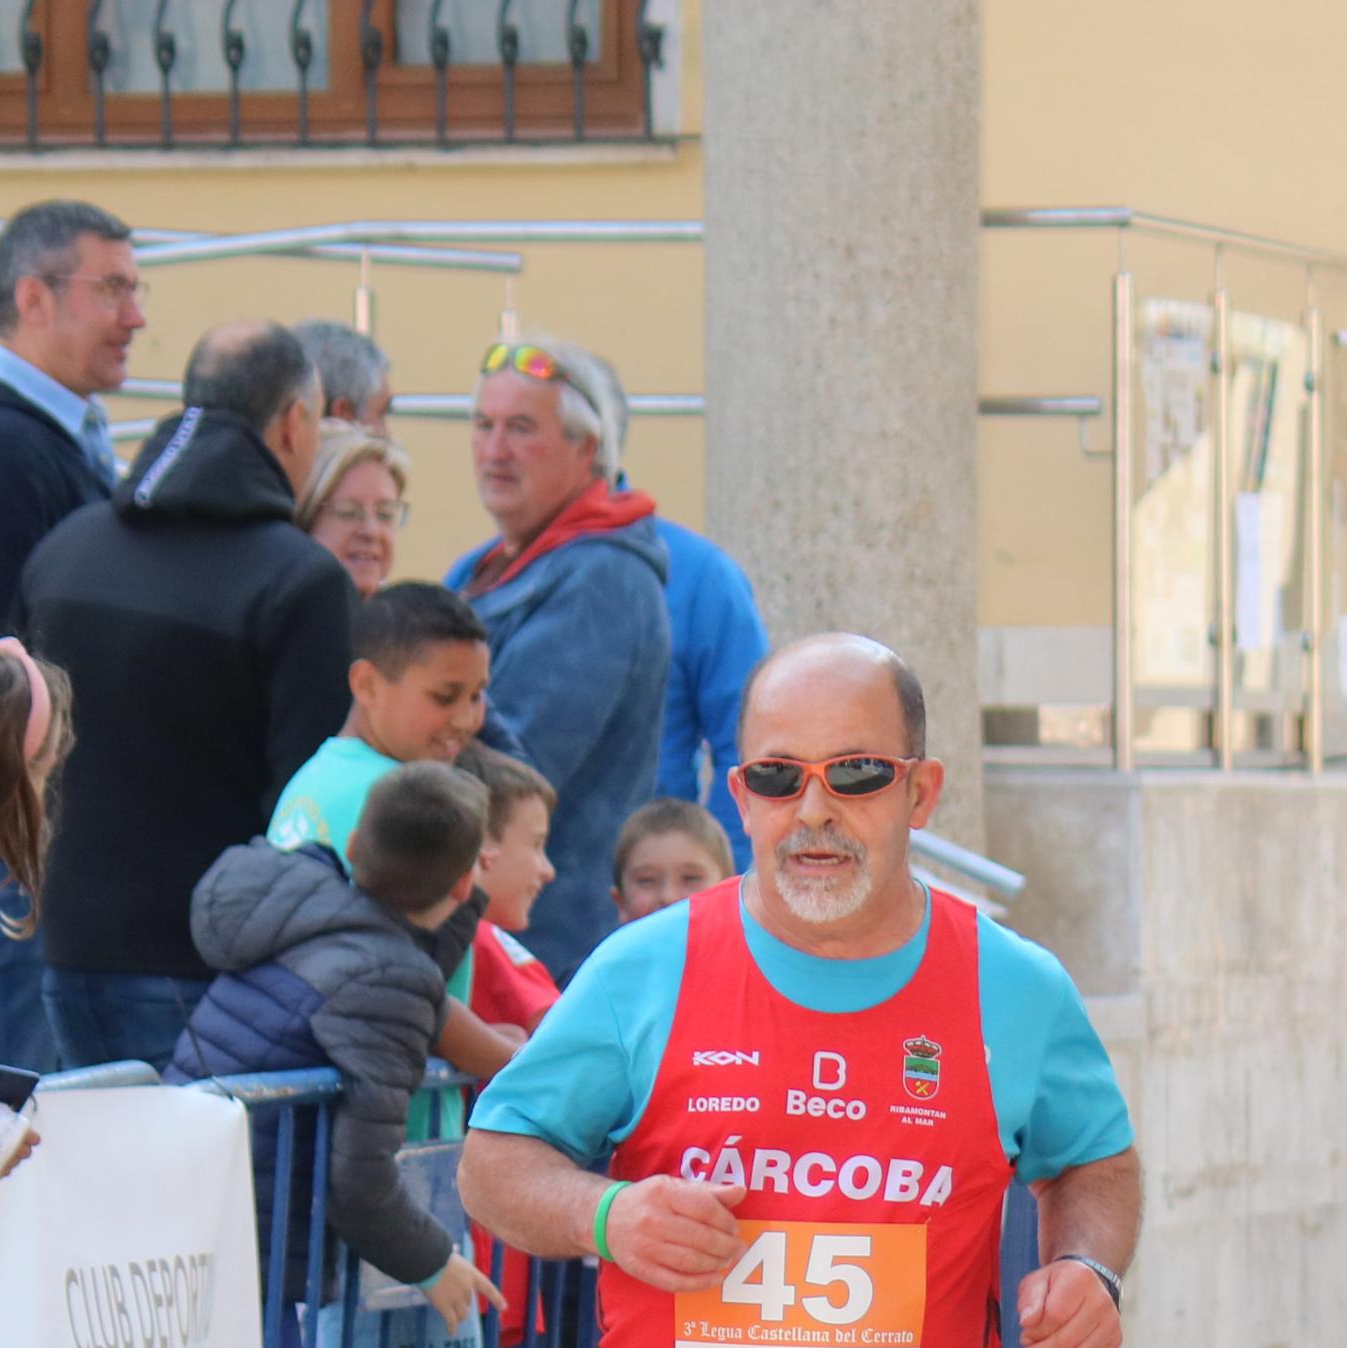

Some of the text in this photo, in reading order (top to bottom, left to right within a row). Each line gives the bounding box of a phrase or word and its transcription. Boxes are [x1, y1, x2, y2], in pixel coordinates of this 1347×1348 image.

[687, 1096, 760, 1113] LOREDO
[786, 1089, 867, 1121] Beco
[680, 1135, 953, 1208] CÁRCOBA
[721, 1231, 874, 1325] 45
[700, 1321, 743, 1341] Legua
[747, 1325, 830, 1343] Castellana
[835, 1328, 857, 1343] del
[861, 1328, 914, 1343] Cerrato
